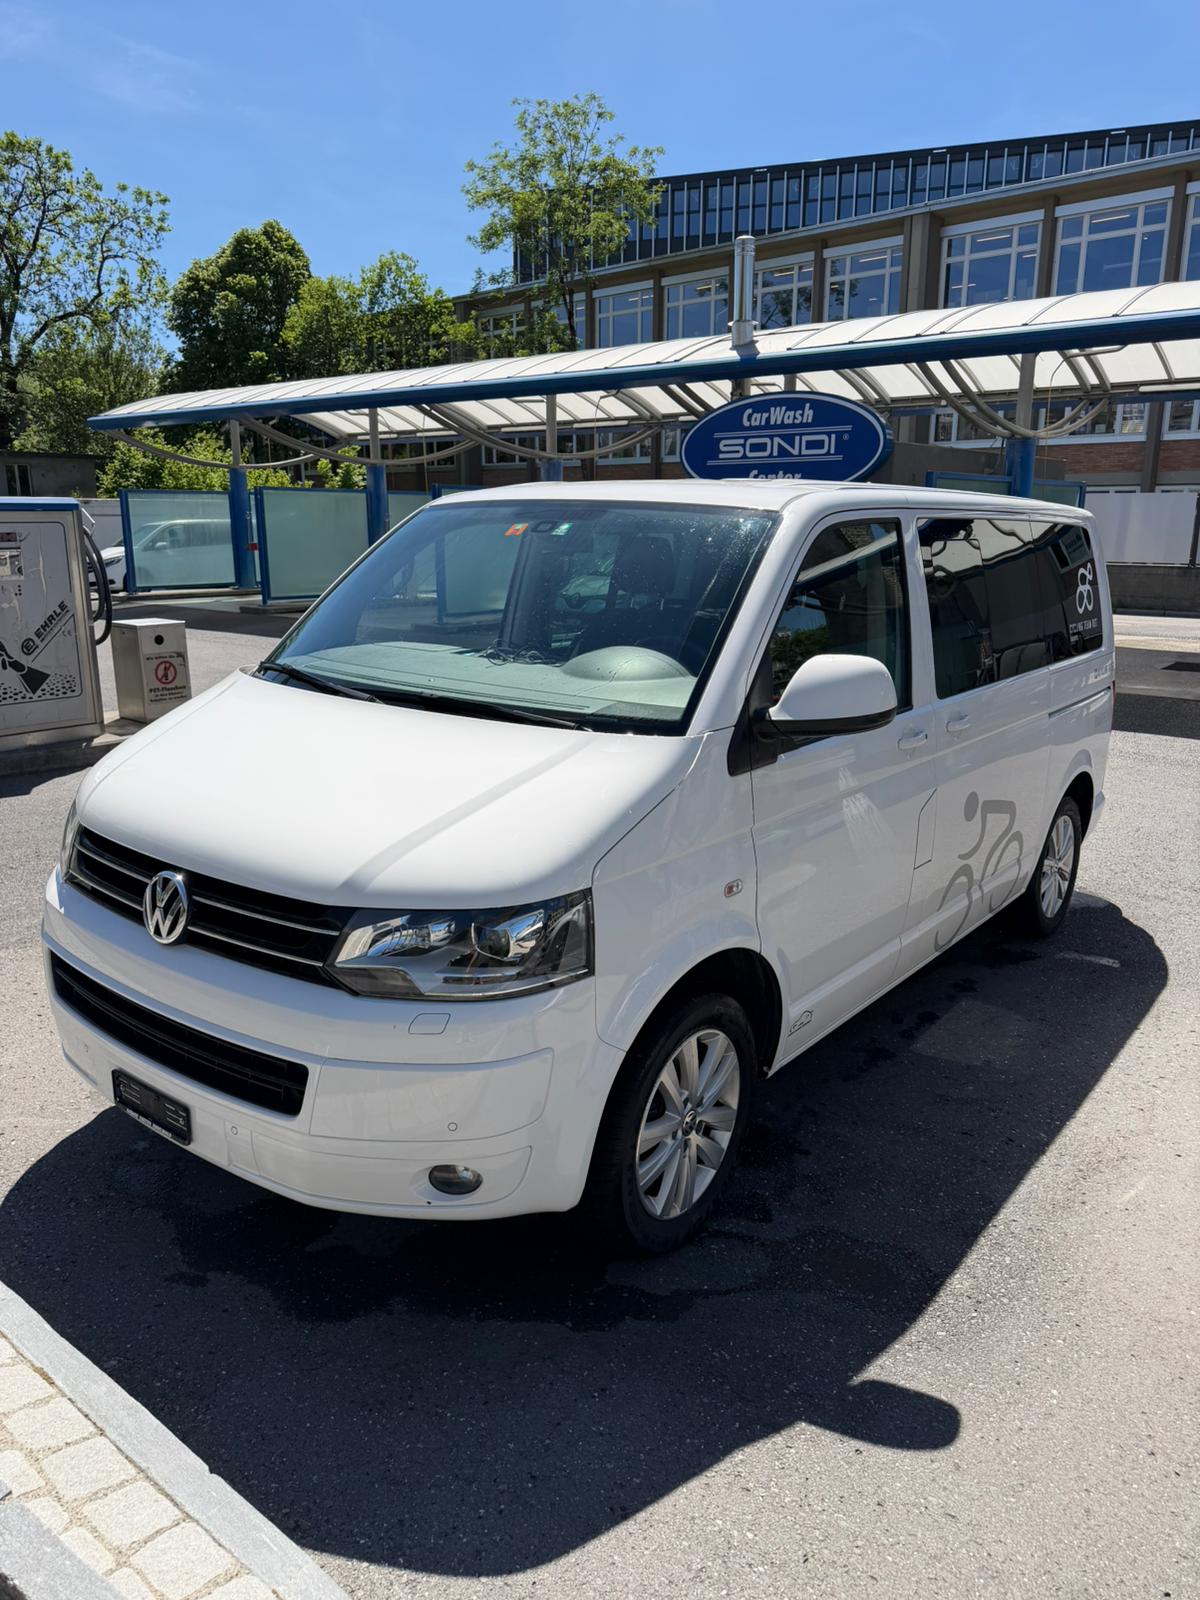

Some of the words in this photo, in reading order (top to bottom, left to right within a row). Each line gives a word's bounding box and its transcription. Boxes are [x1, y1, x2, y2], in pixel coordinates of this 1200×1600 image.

[742, 403, 814, 427] CarWash
[718, 433, 836, 459] SONDI
[34, 600, 69, 640] EHRLE
